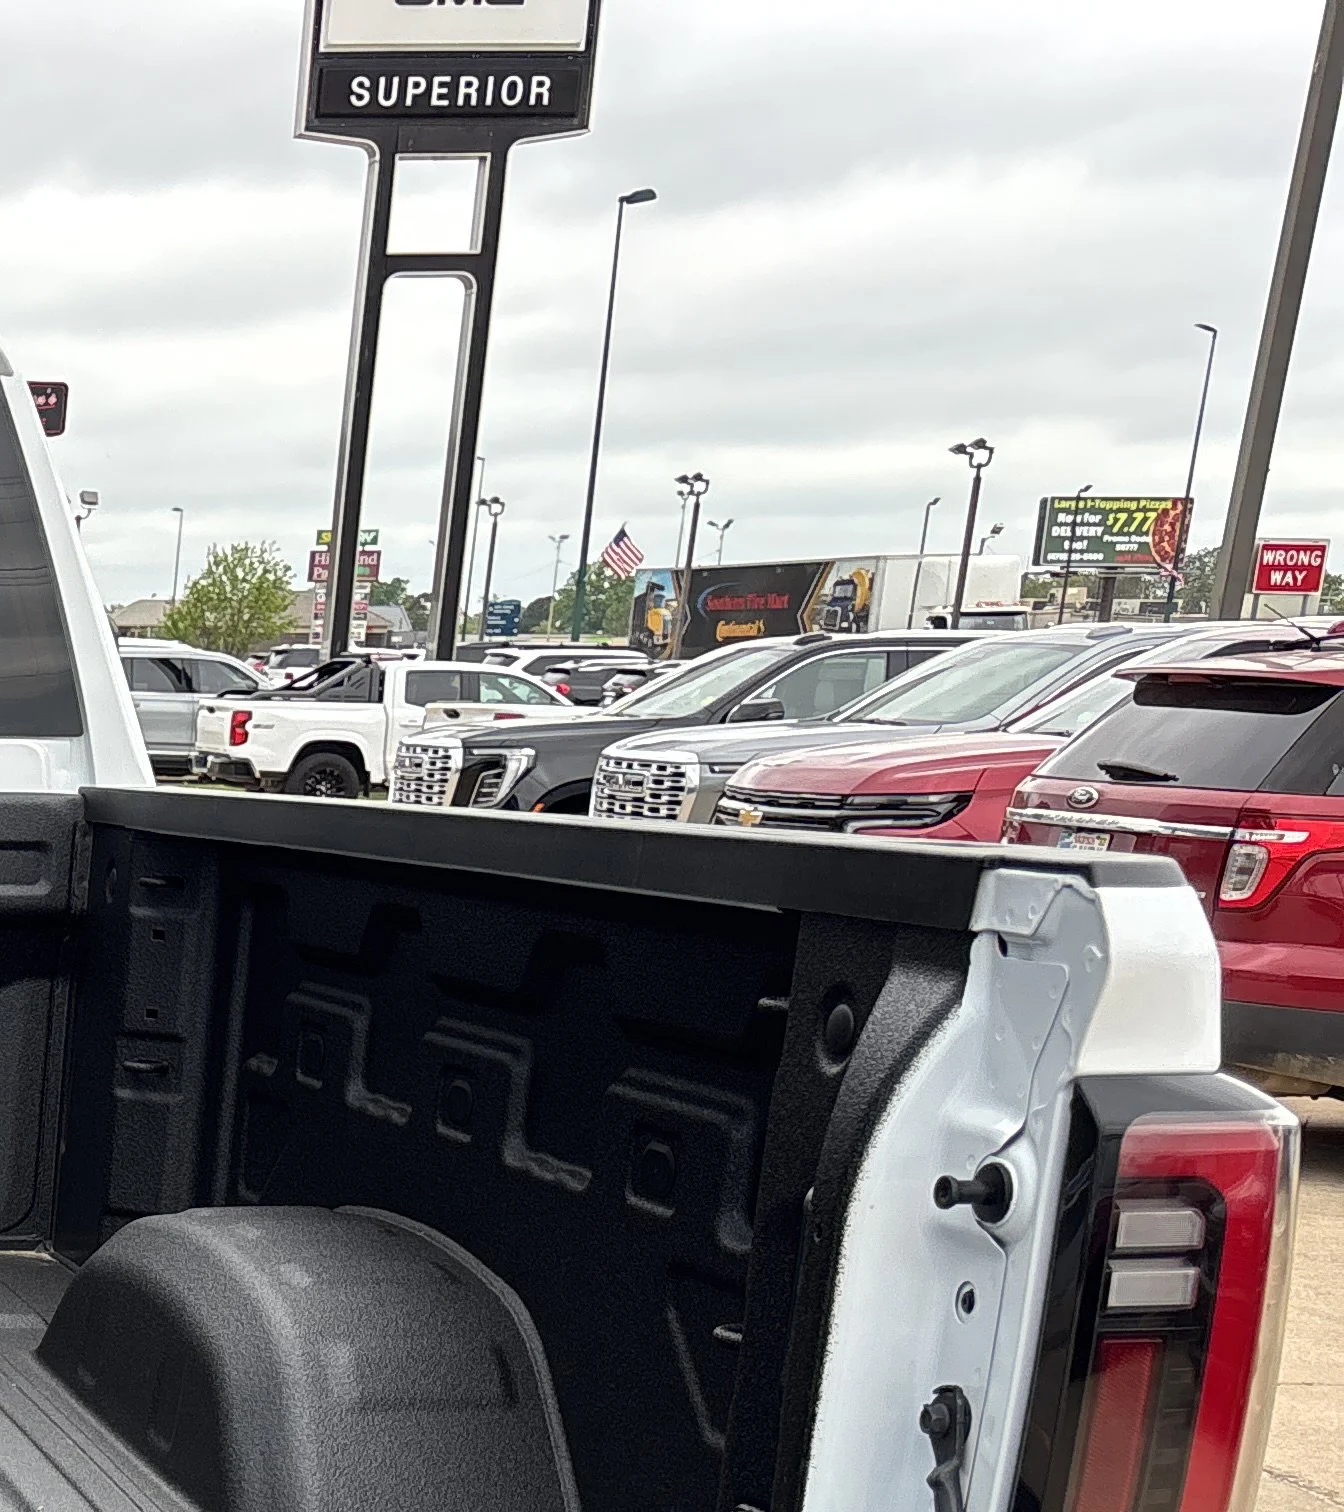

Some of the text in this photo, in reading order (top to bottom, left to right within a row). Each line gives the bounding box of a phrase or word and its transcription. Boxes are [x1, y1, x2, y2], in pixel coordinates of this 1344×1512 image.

[349, 75, 552, 108] SUPERIOR
[1139, 499, 1172, 509] Pizzas
[1083, 512, 1102, 523] for
[1106, 512, 1158, 533] $7.77
[1051, 526, 1104, 537] DELVERY
[1262, 549, 1322, 566] WRONG
[1270, 570, 1308, 587] WAY
